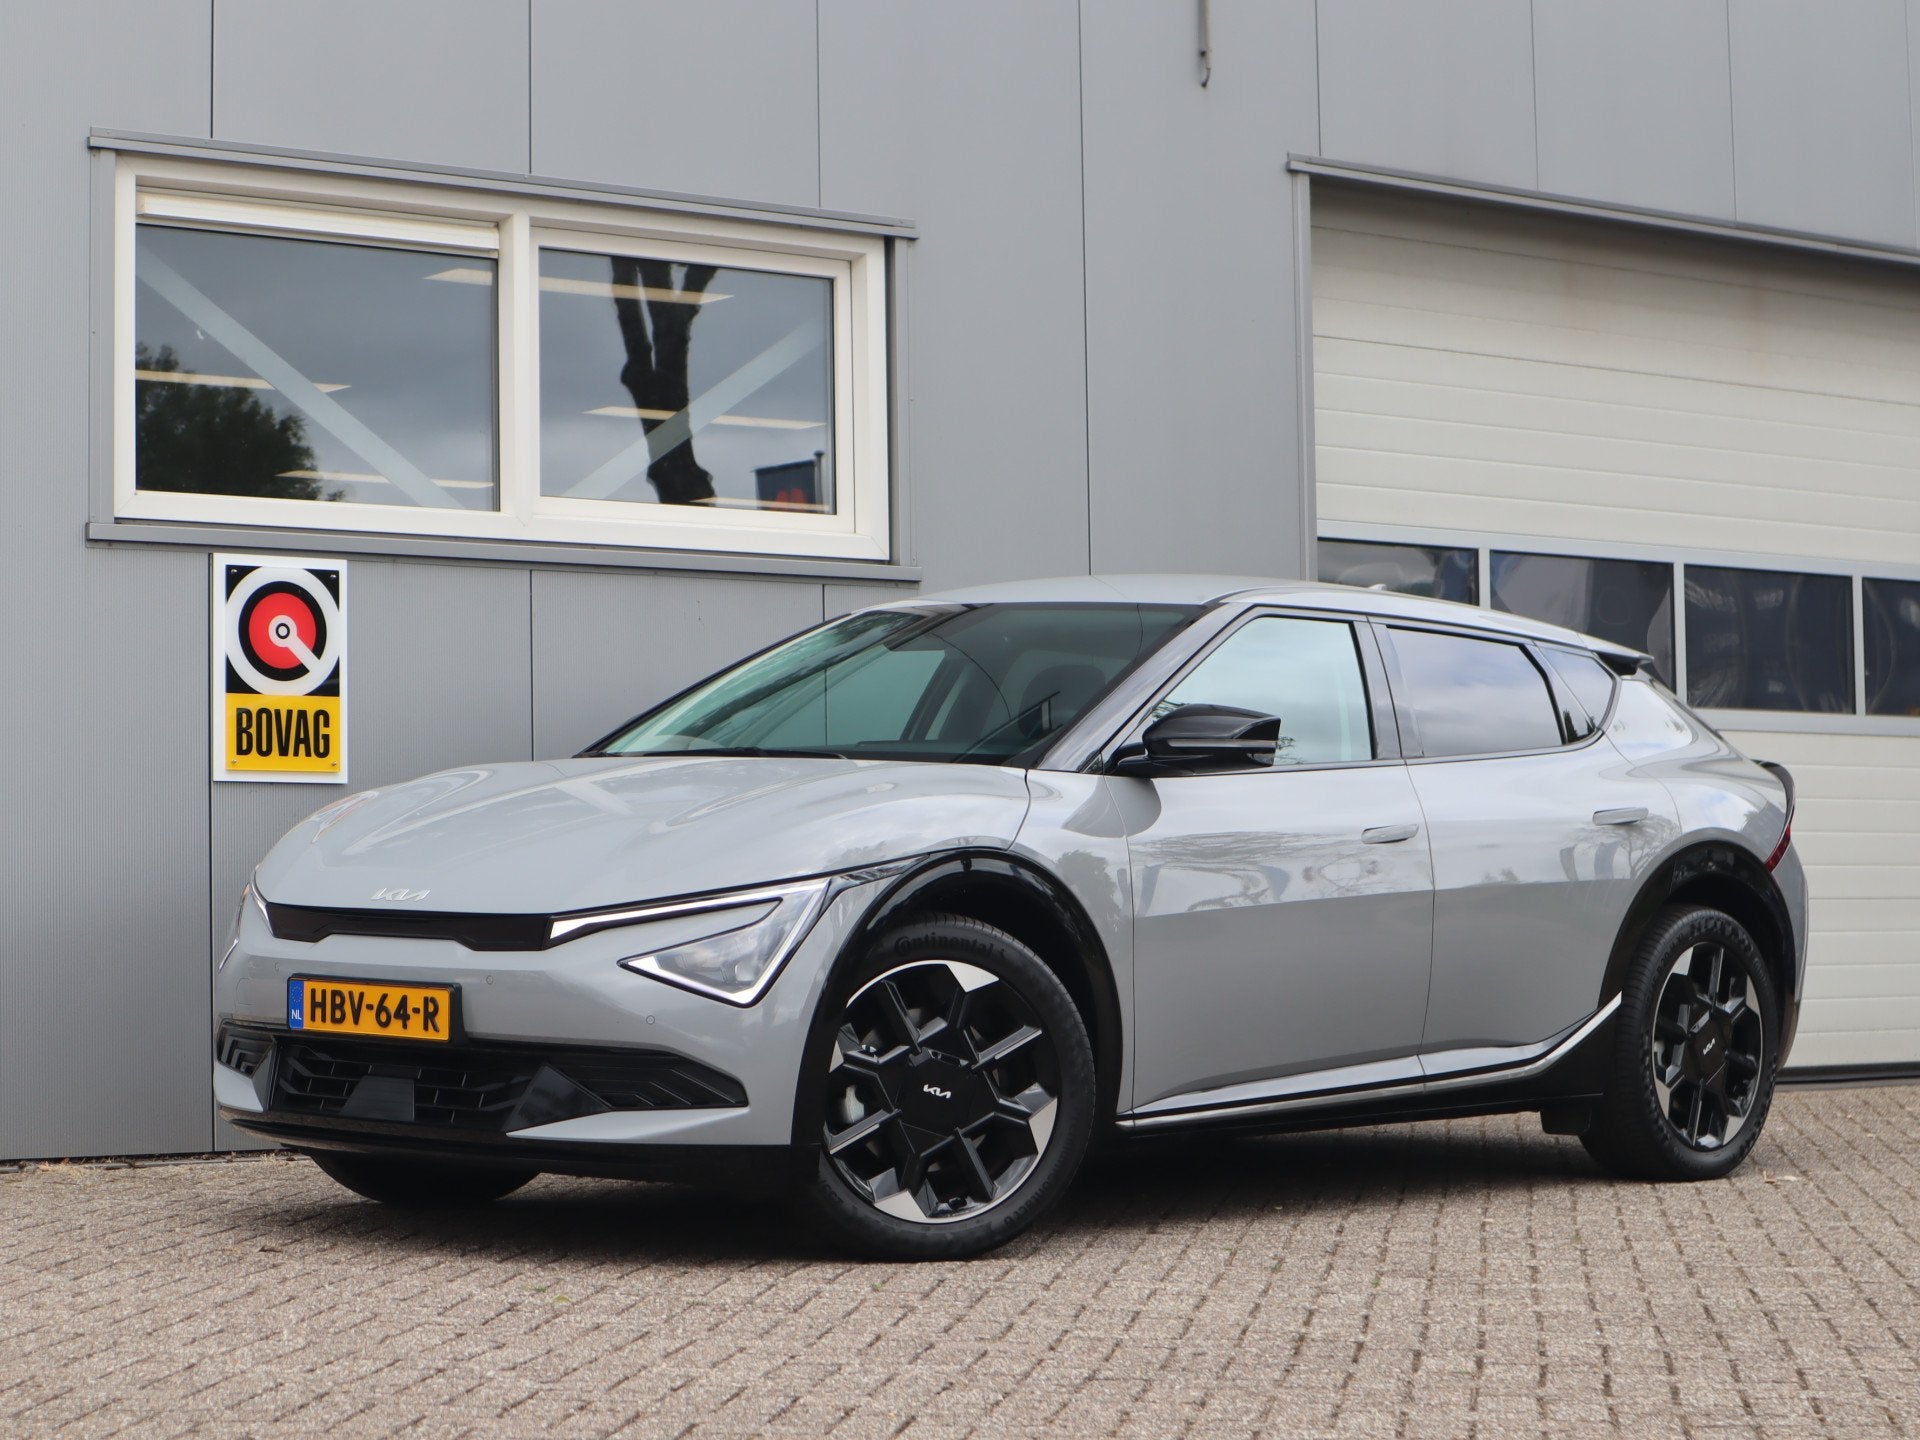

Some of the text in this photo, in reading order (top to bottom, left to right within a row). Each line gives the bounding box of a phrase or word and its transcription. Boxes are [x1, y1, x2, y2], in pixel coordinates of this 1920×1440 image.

[236, 707, 330, 759] BOVAG
[370, 887, 431, 901] KIA
[895, 932, 995, 957] Continental
[291, 1009, 302, 1020] NL
[310, 987, 440, 1033] HBV-64-R
[923, 1084, 951, 1099] KIA
